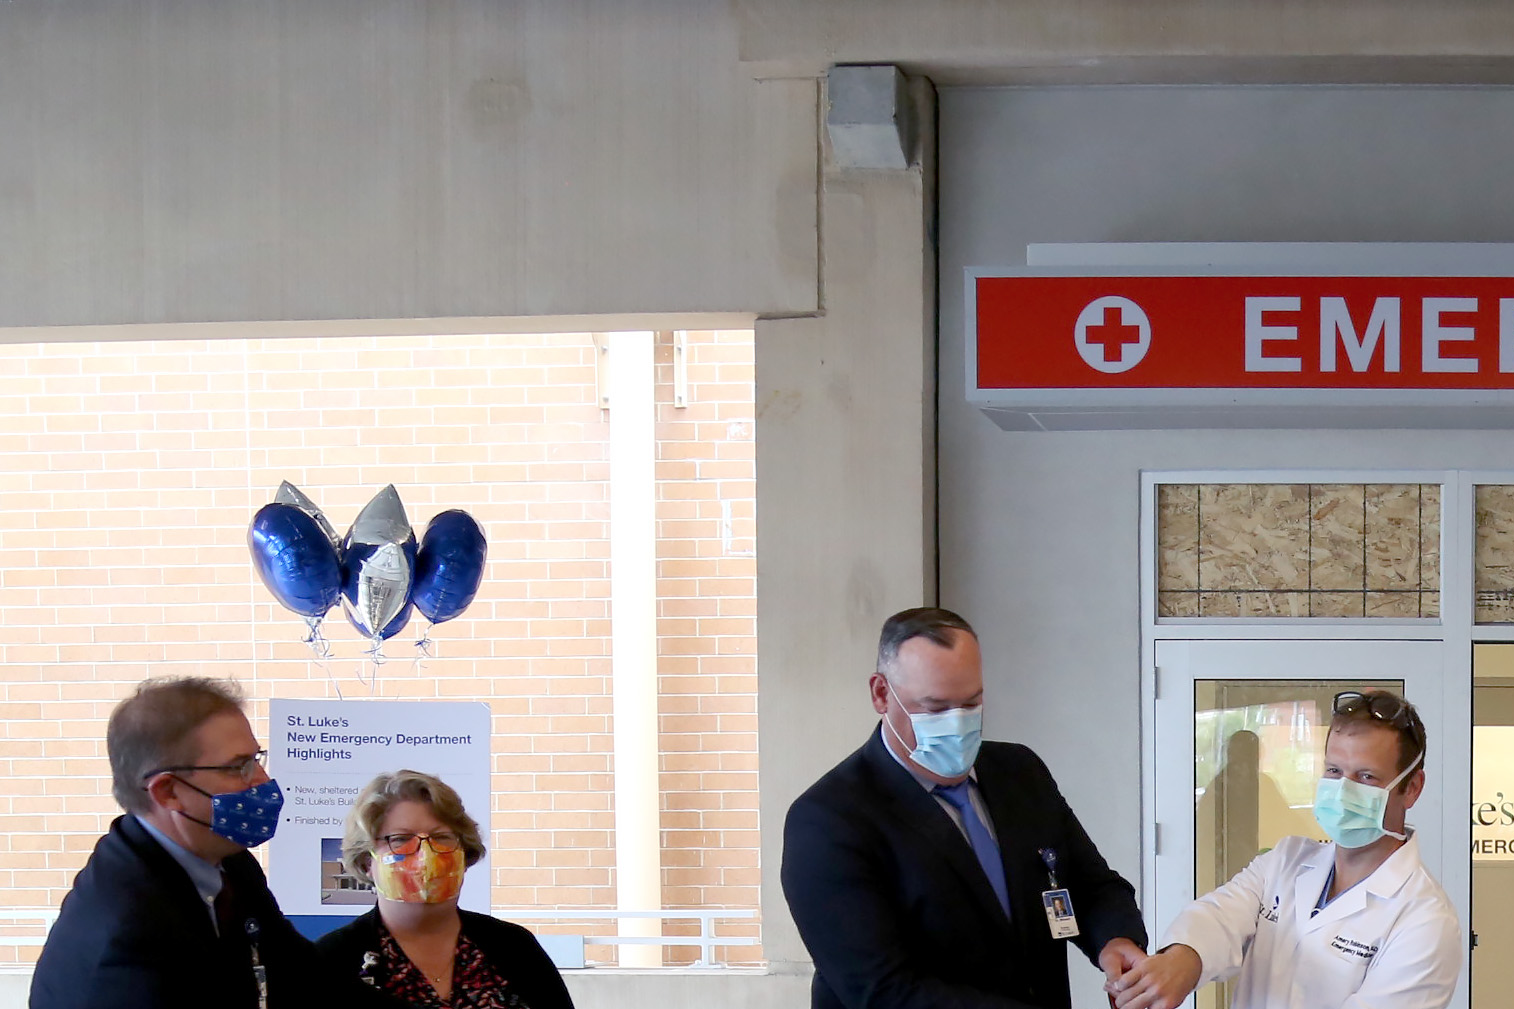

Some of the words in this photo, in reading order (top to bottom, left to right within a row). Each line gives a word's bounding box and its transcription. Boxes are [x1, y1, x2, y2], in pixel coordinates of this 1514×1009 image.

[287, 716, 304, 727] St.
[308, 716, 349, 728] Luke's
[287, 732, 316, 744] New
[320, 733, 392, 746] Emergency
[396, 733, 472, 746] Department
[287, 748, 352, 761] Highlights
[294, 786, 316, 795] New,
[319, 786, 358, 794] sheltered
[295, 797, 306, 805] St.
[309, 798, 335, 806] Luke's
[295, 816, 330, 825] Finished
[333, 817, 343, 826] by
